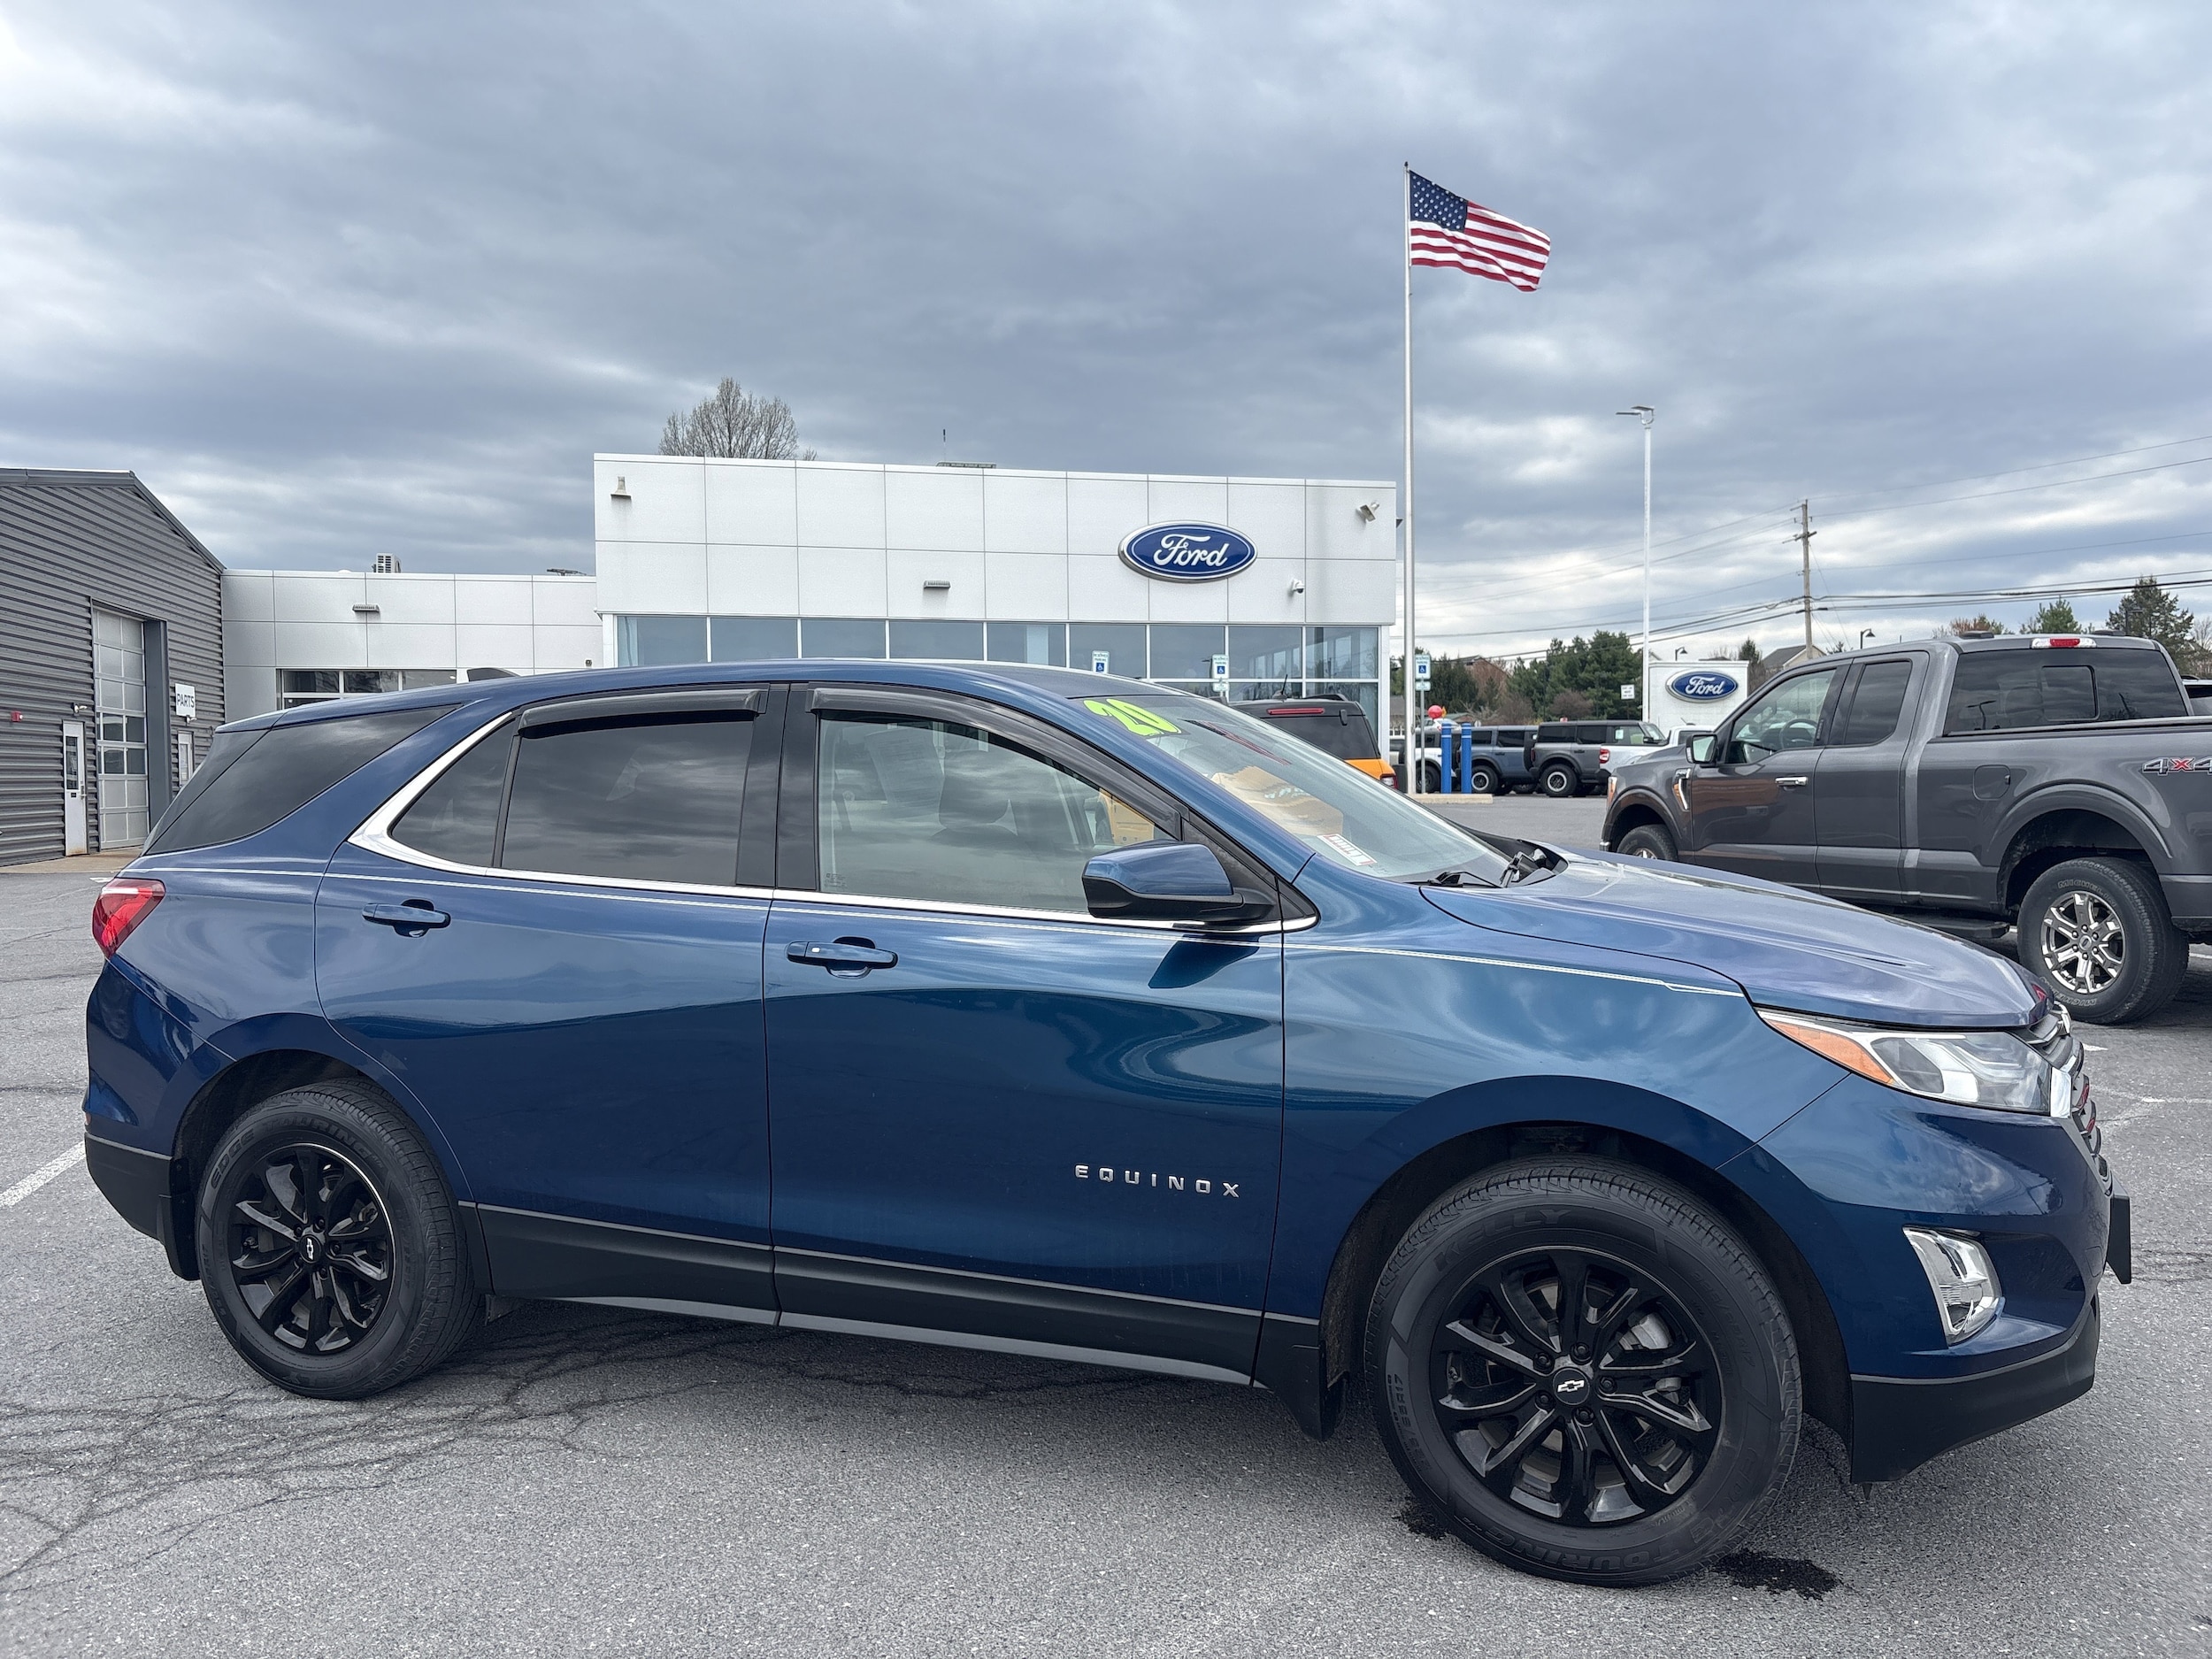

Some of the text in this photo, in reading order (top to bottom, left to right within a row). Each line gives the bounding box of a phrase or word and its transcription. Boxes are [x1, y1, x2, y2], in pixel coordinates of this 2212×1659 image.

[1153, 534, 1230, 567] Ford
[176, 693, 195, 709] PARTS
[1685, 676, 1725, 695] Ford
[1083, 698, 1182, 736] 20
[2057, 879, 2117, 909] MICHELIN
[2039, 976, 2098, 1007] MICHEL
[211, 1127, 256, 1189] EDGE
[265, 1116, 373, 1160] TOURING
[1075, 1164, 1240, 1198] EQUINOX
[1433, 1209, 1572, 1272] KELLY
[1485, 1526, 1679, 1571] TOURING
